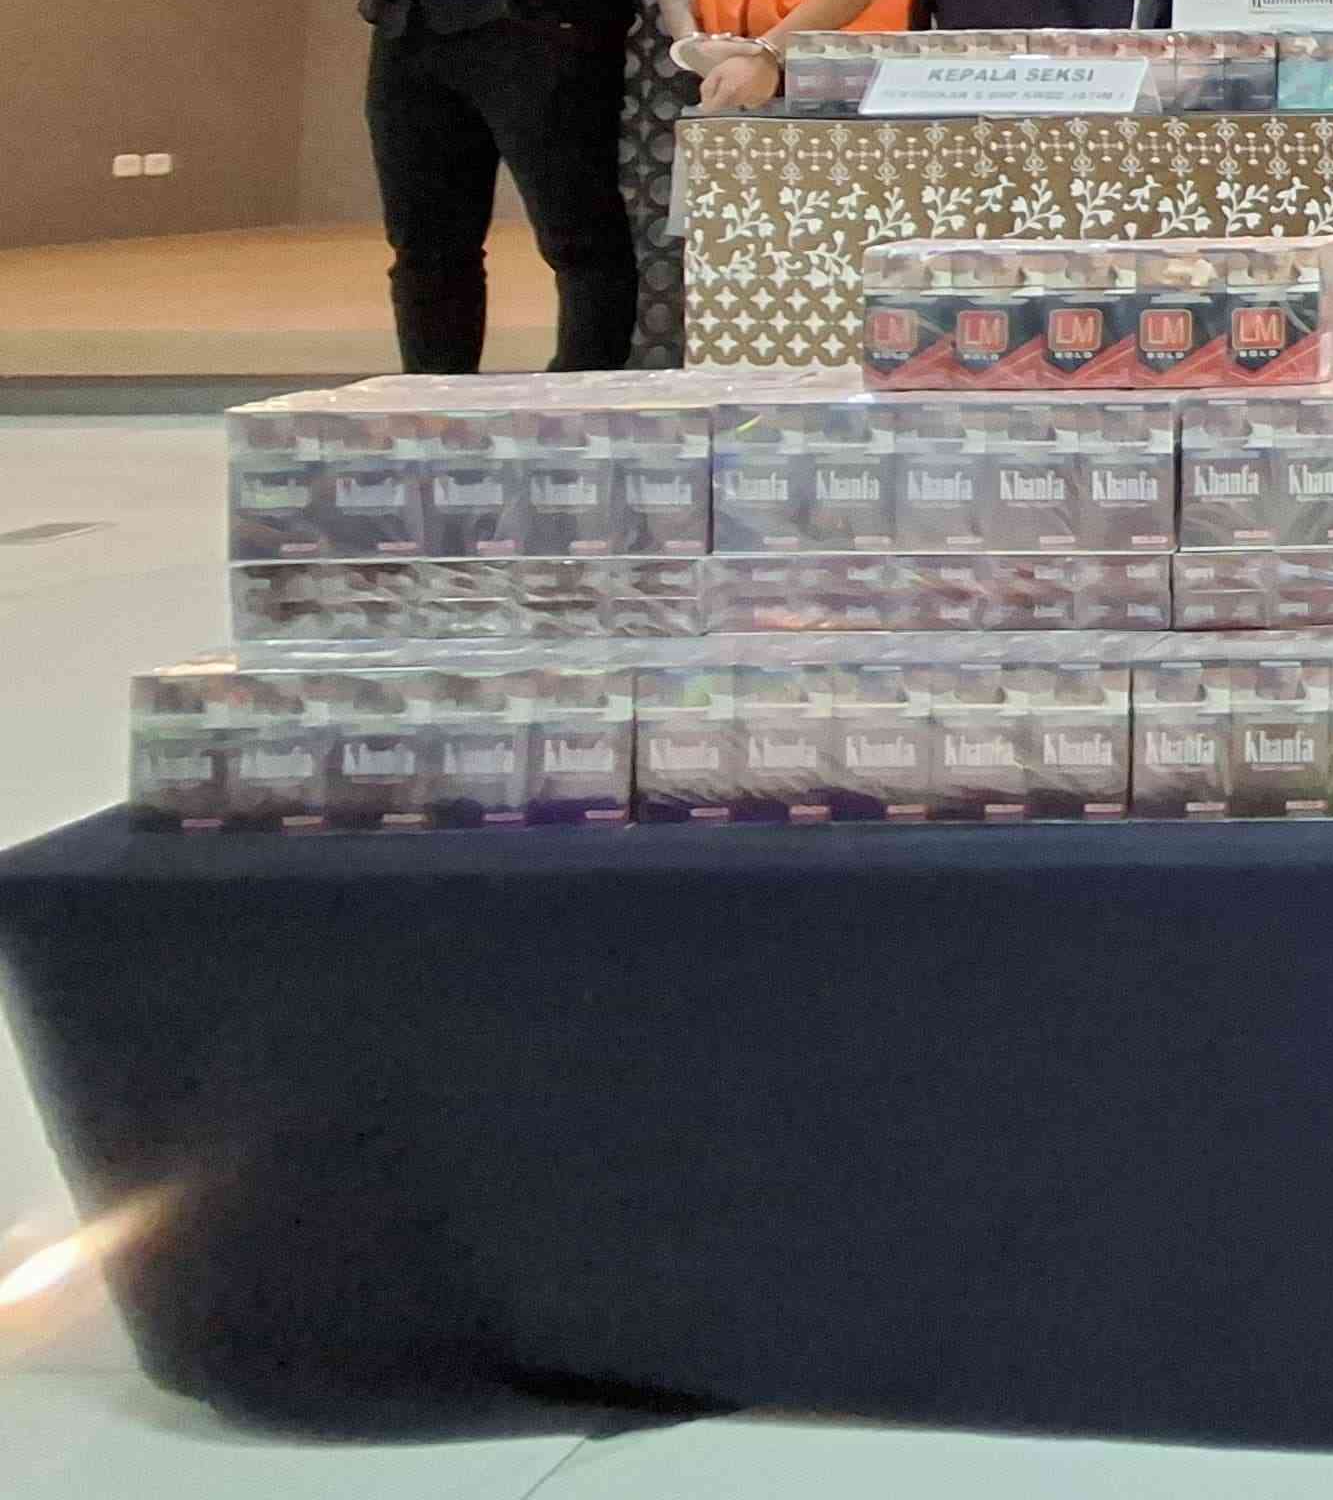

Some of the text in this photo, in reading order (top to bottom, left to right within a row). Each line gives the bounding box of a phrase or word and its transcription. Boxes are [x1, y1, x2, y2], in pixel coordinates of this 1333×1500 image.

[928, 67, 1095, 82] KEPALA SEKSI
[963, 318, 1002, 346] LM
[1055, 316, 1096, 345] LM
[1147, 317, 1187, 345] LM
[1239, 315, 1278, 343] LM
